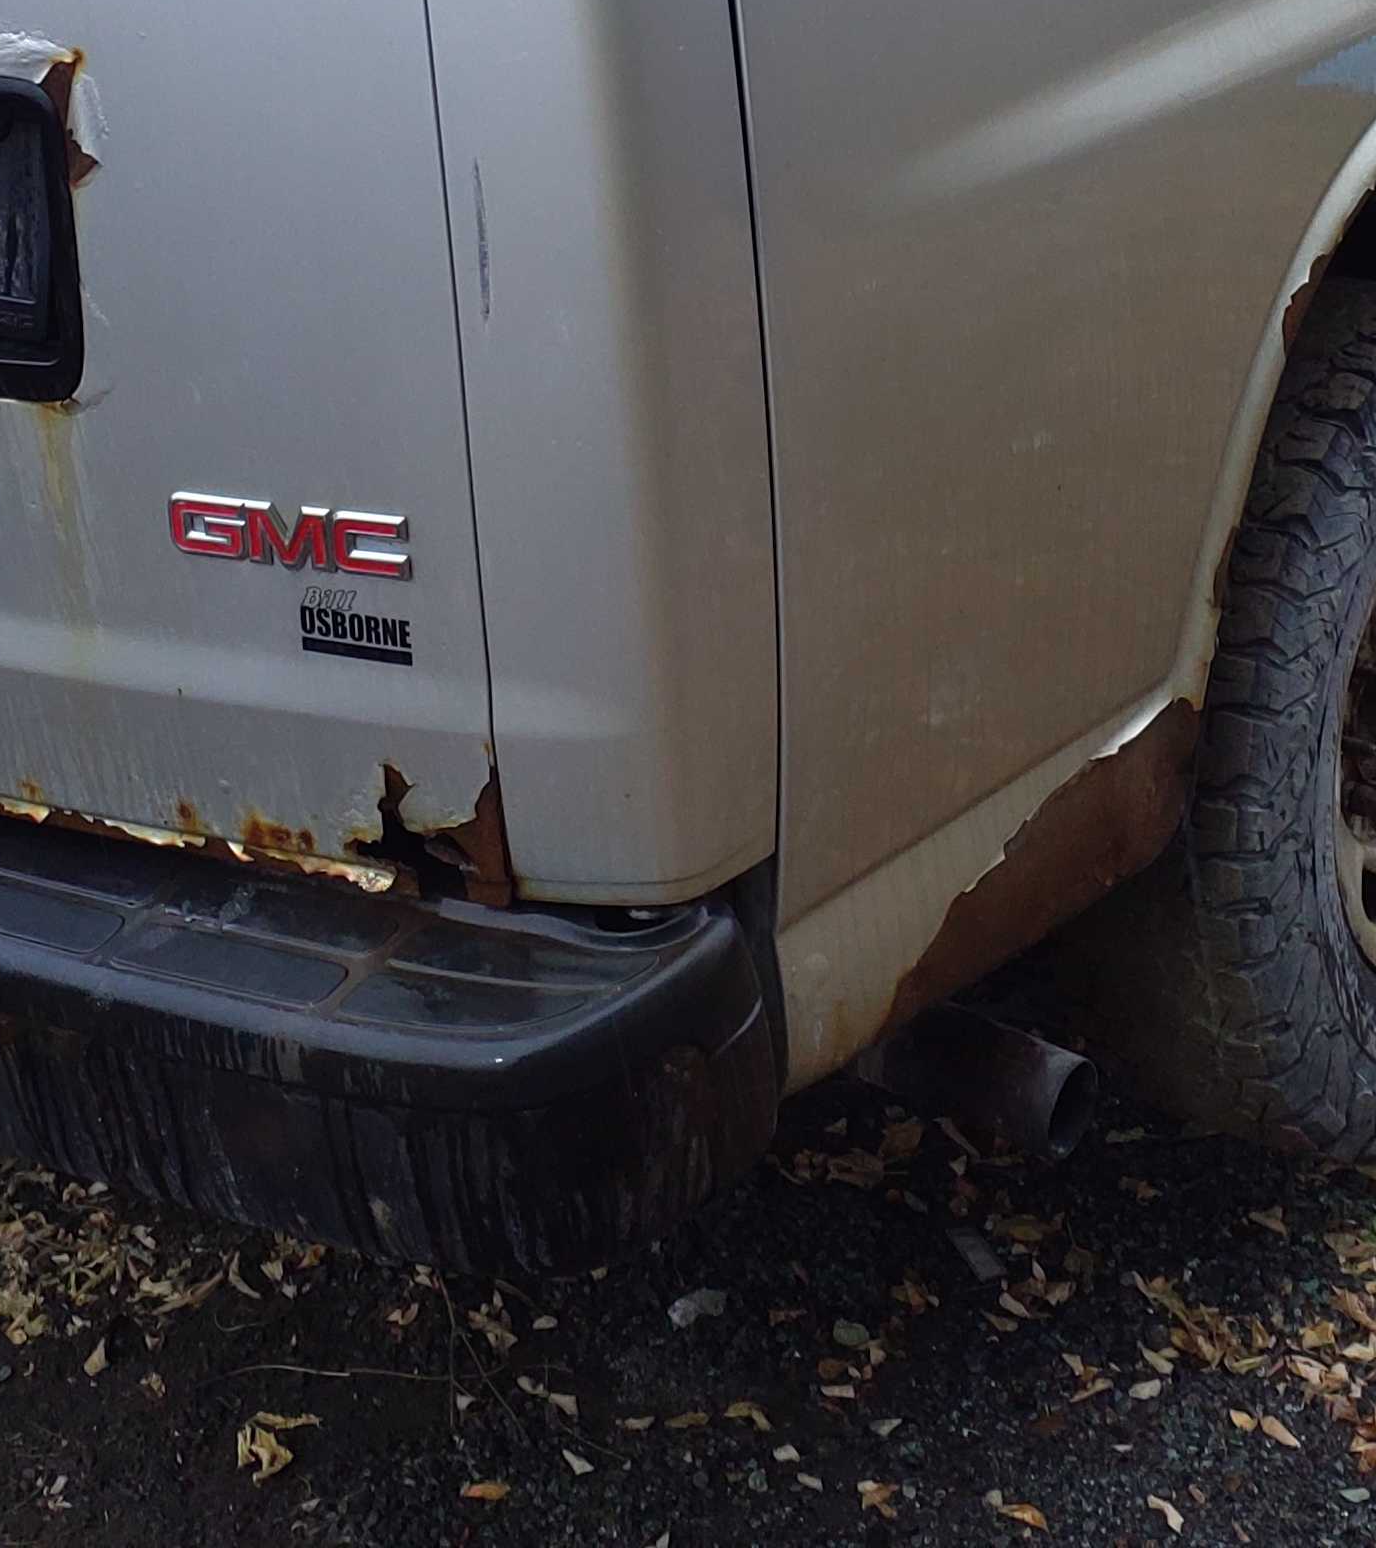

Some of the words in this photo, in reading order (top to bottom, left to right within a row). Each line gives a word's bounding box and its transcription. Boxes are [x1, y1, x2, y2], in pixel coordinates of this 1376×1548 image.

[169, 490, 413, 582] GMC
[301, 585, 358, 612] Bill
[299, 605, 413, 650] OSBORNE
